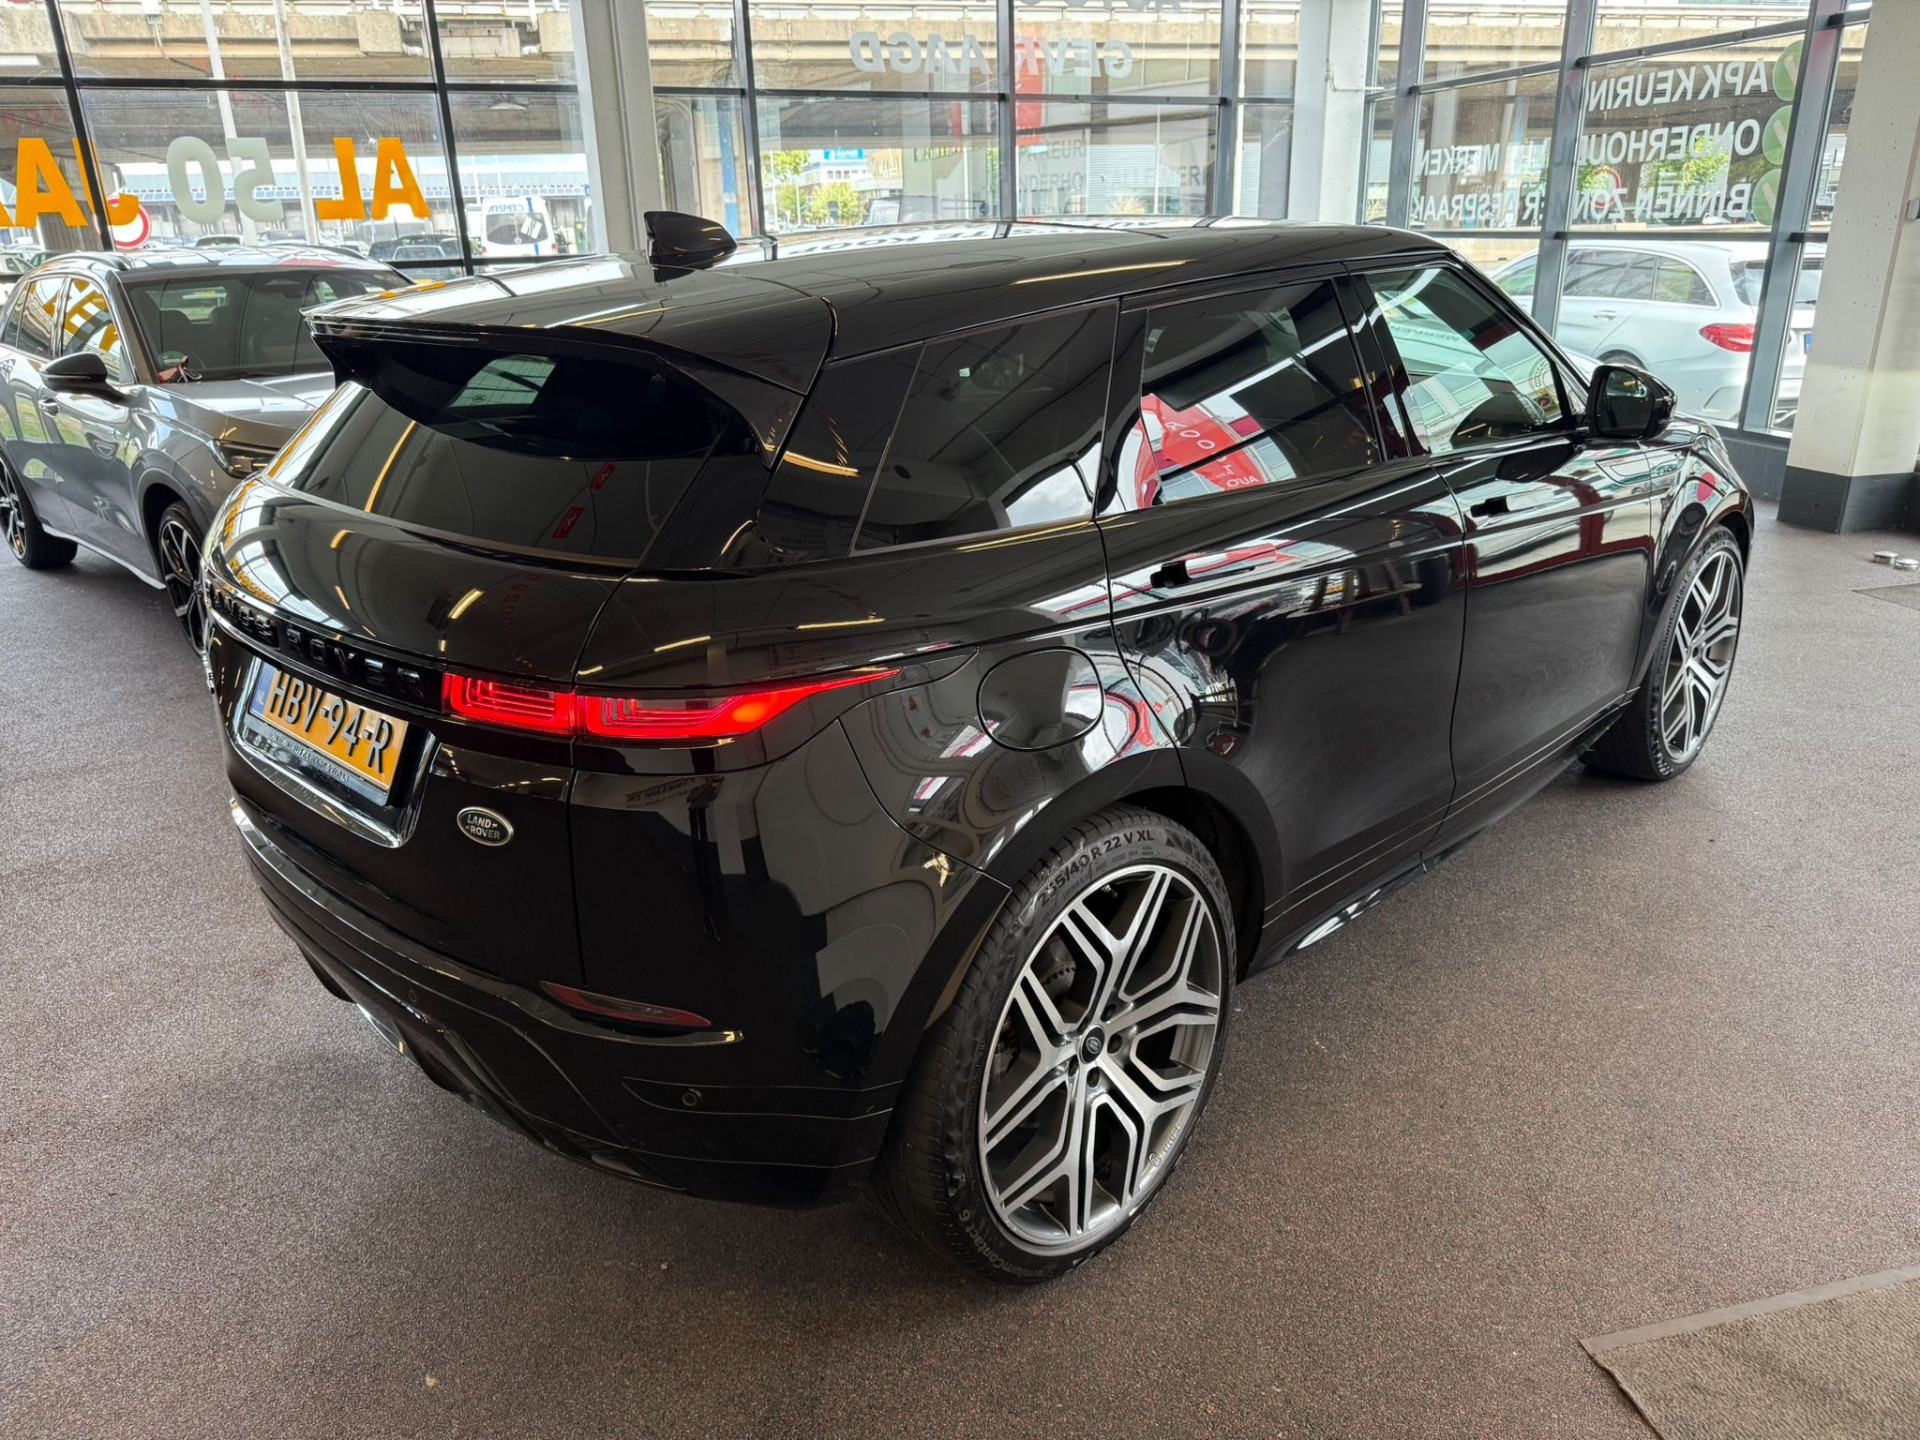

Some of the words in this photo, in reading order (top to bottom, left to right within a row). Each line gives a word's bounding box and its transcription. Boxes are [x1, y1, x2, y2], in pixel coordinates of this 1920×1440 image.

[284, 625, 425, 698] ROVER
[269, 669, 395, 774] HBV-94-R
[466, 813, 492, 829] LAND
[469, 825, 501, 840] ROVER
[1090, 845, 1104, 860] R
[1104, 836, 1123, 853] 22
[1123, 831, 1134, 845] V
[1136, 829, 1155, 842] XL
[965, 1222, 1057, 1278] remiumContact
